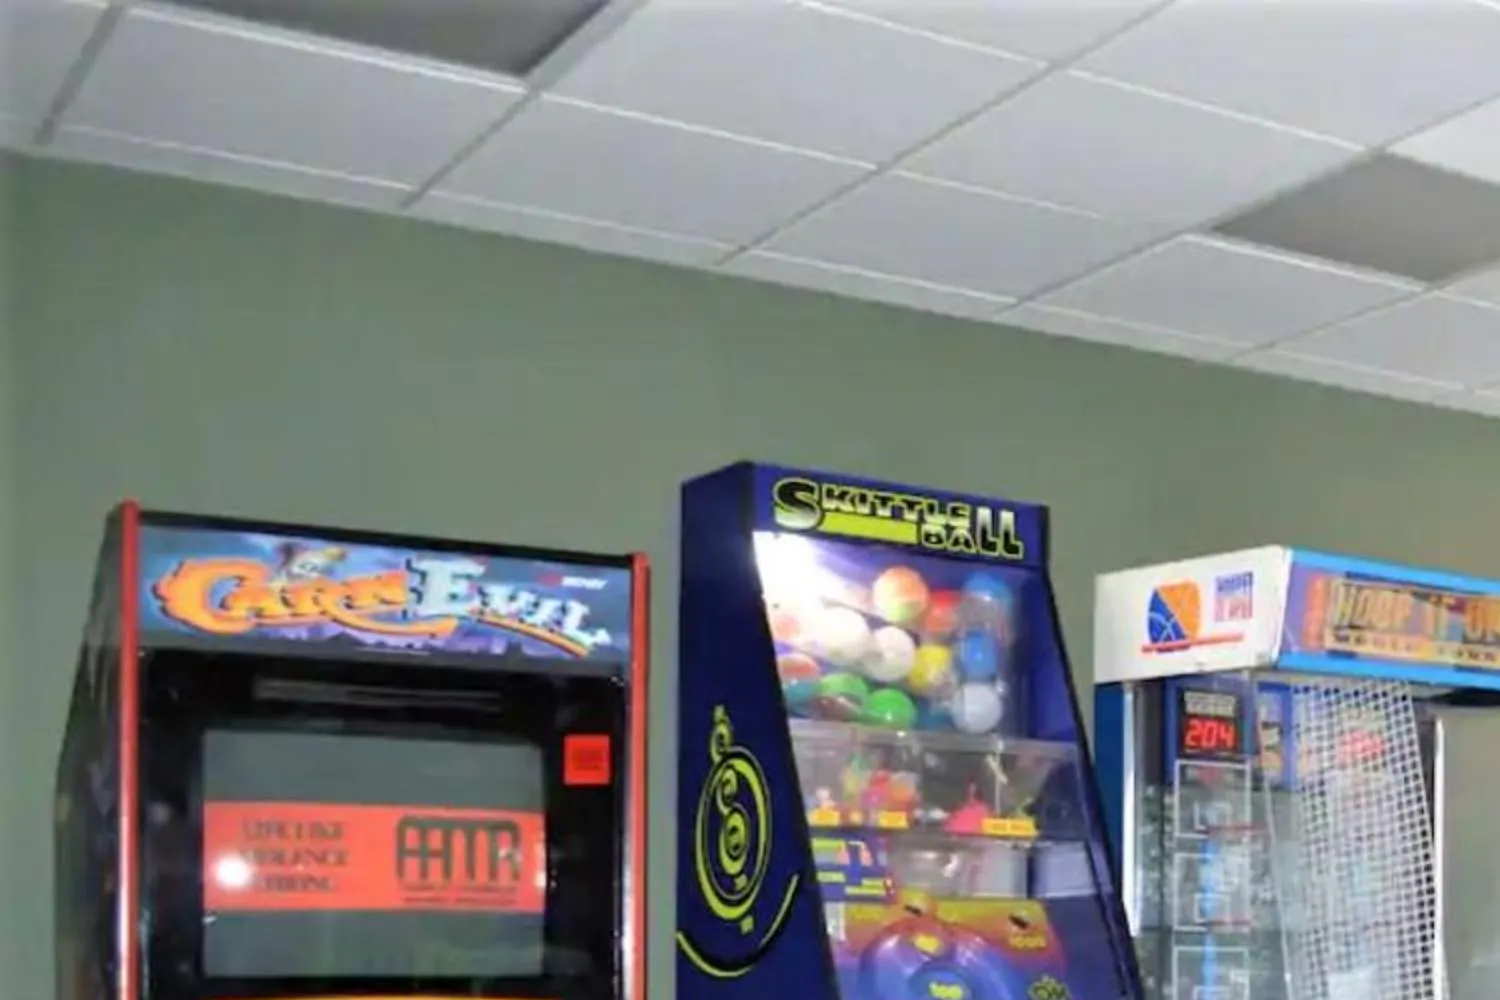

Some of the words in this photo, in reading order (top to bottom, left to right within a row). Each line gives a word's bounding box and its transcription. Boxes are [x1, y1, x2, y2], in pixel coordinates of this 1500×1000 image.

[773, 477, 971, 530] SKITTLE
[921, 506, 1024, 559] BALL
[1184, 719, 1235, 750] 204
